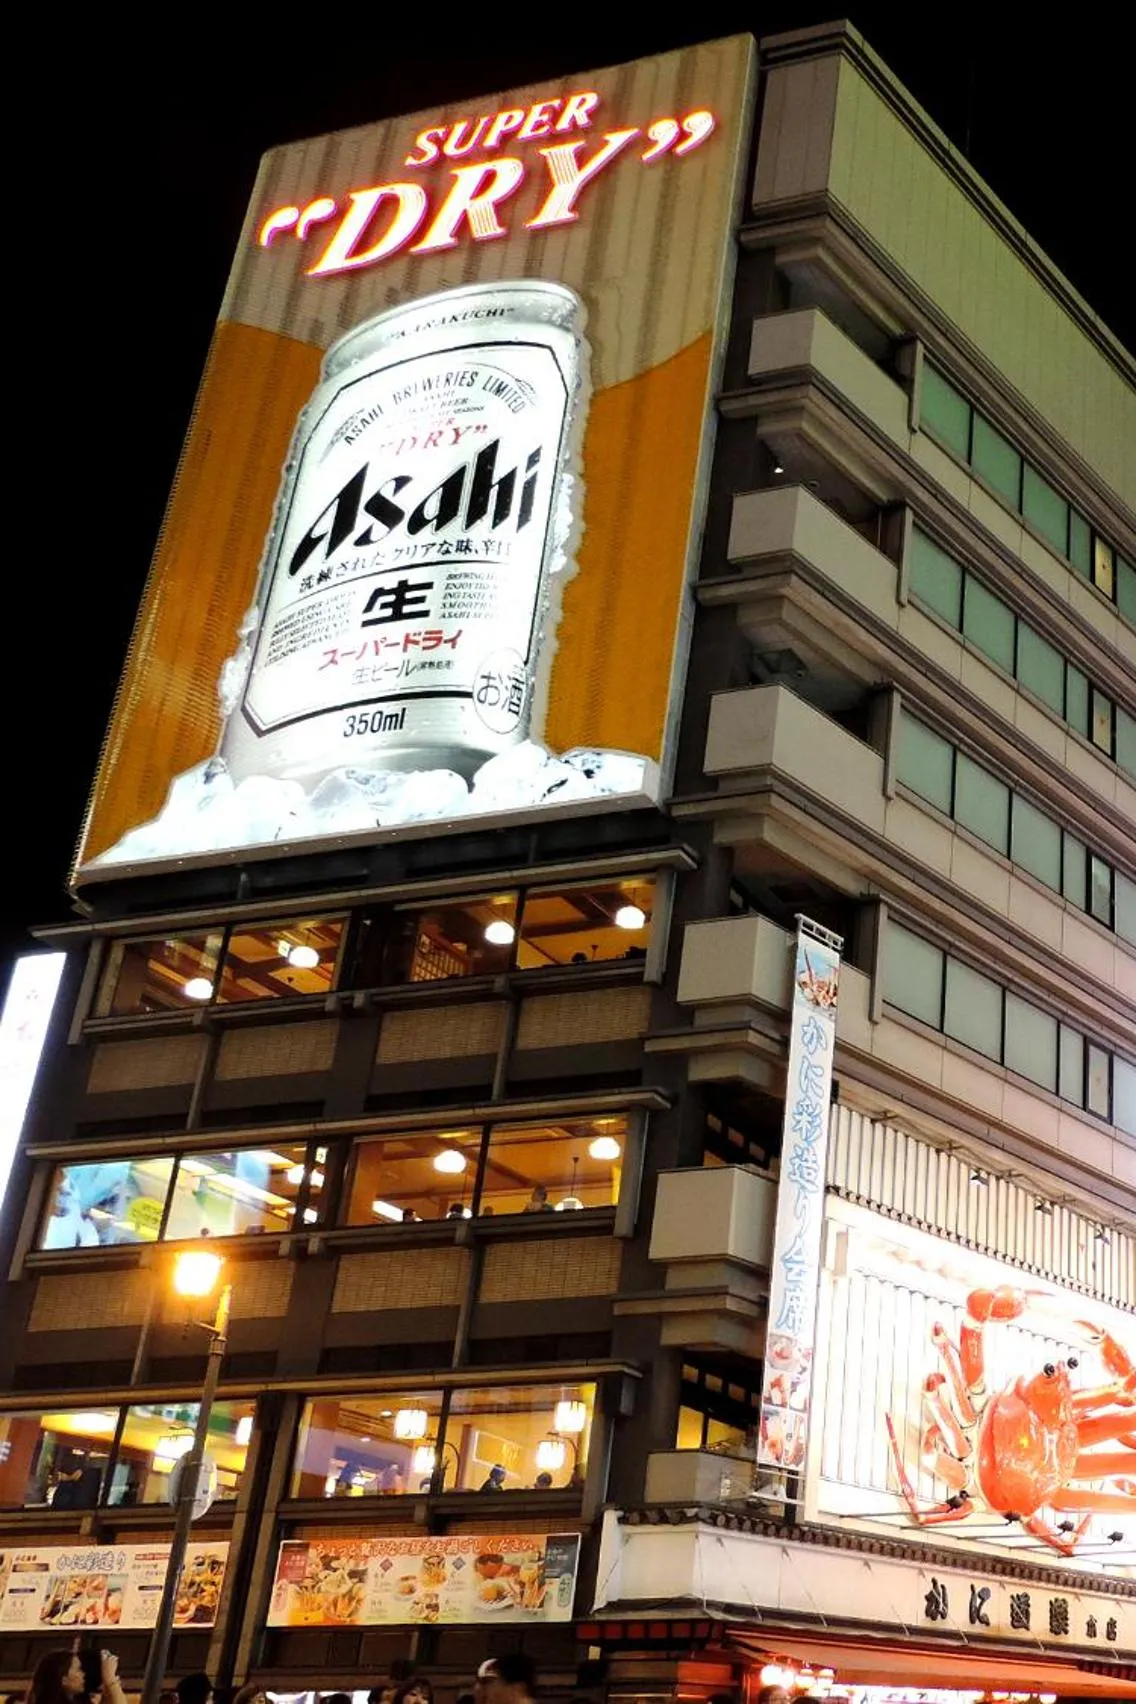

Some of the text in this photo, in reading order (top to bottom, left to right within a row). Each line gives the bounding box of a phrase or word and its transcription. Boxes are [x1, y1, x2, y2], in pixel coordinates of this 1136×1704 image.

[404, 90, 601, 167] SUPER
[392, 370, 479, 406] BREWERIES
[482, 374, 527, 415] LIMITED
[287, 438, 543, 577] Asahi
[361, 578, 435, 628] 生
[318, 629, 463, 672] スーパードライ
[343, 708, 408, 738] 350ml
